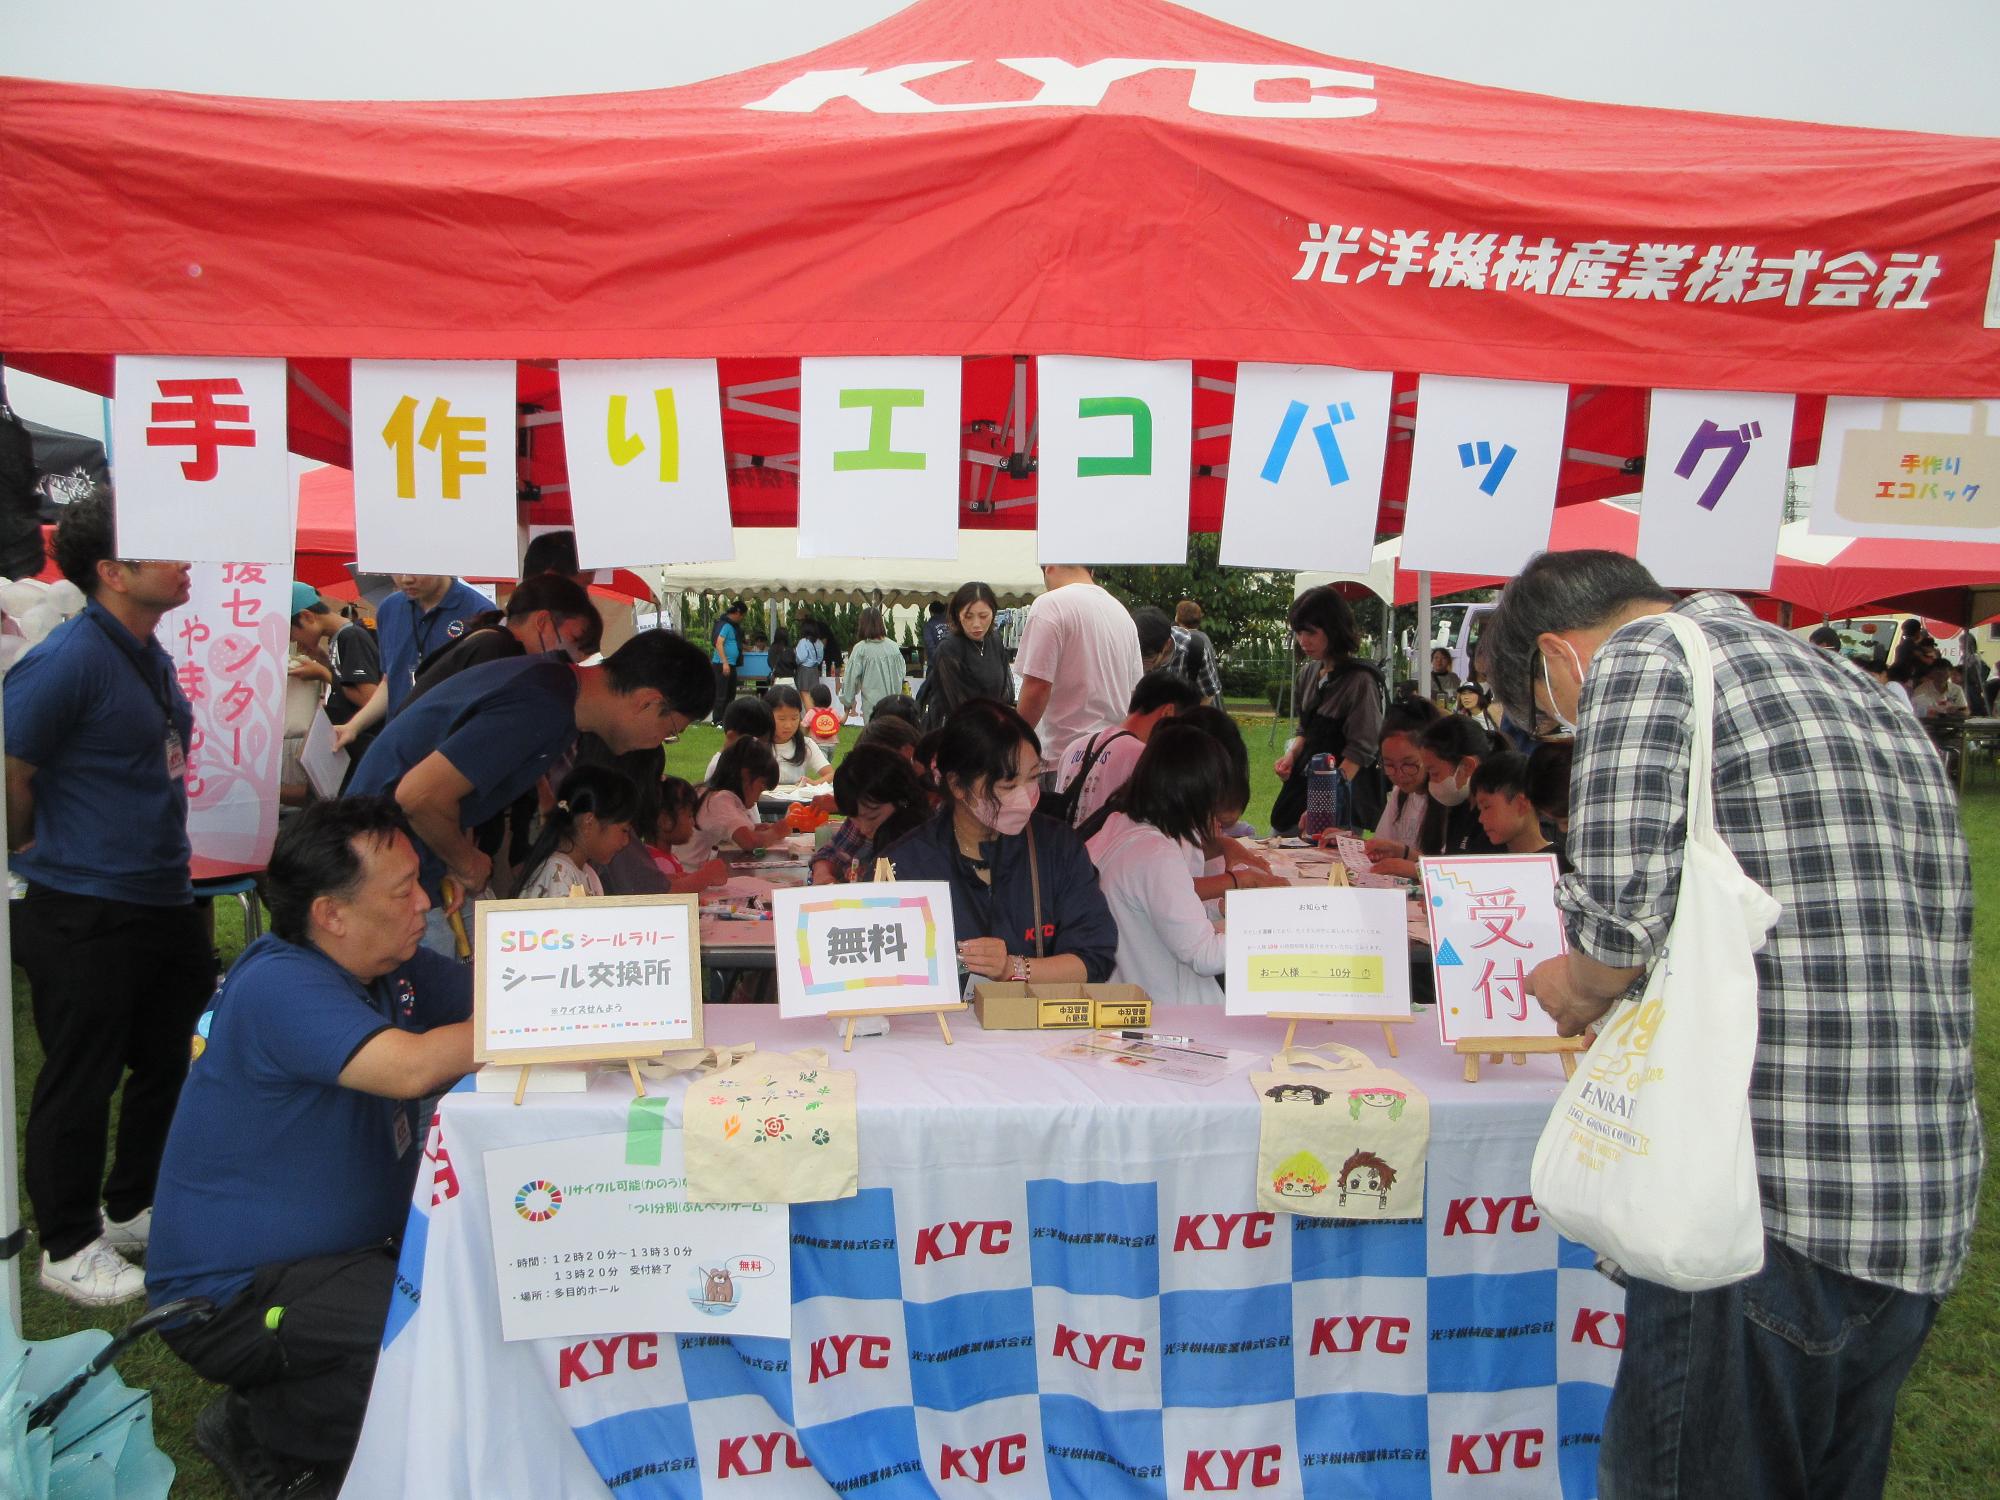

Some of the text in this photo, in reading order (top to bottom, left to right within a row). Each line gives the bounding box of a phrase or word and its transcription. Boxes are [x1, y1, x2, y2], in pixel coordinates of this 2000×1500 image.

[742, 57, 1378, 119] KYC
[1292, 222, 1942, 311] 光洋機械産業株式会社
[1900, 454, 1961, 475] 手作り
[1299, 903, 1329, 912] お知らせ
[500, 928, 675, 953] SDGs シールラリー
[826, 922, 908, 966] 無料
[1024, 924, 1056, 942] KC
[1465, 886, 1534, 1022] 受付
[501, 959, 672, 993] シール交換所
[1260, 967, 1351, 978] お一人様 10分
[1174, 1211, 1276, 1252] KYC
[1443, 1195, 1542, 1236] KYC
[915, 1220, 1013, 1265] KYC
[630, 1263, 673, 1276] 受付終了
[738, 1259, 762, 1273] 無料
[1053, 1323, 1146, 1371] KYC
[1309, 1315, 1411, 1356] KYC
[559, 1332, 658, 1388] KYC
[808, 1334, 892, 1384] KYC
[941, 1433, 1027, 1484] KYC
[1184, 1444, 1281, 1491] KYC
[1447, 1428, 1544, 1475] KYC
